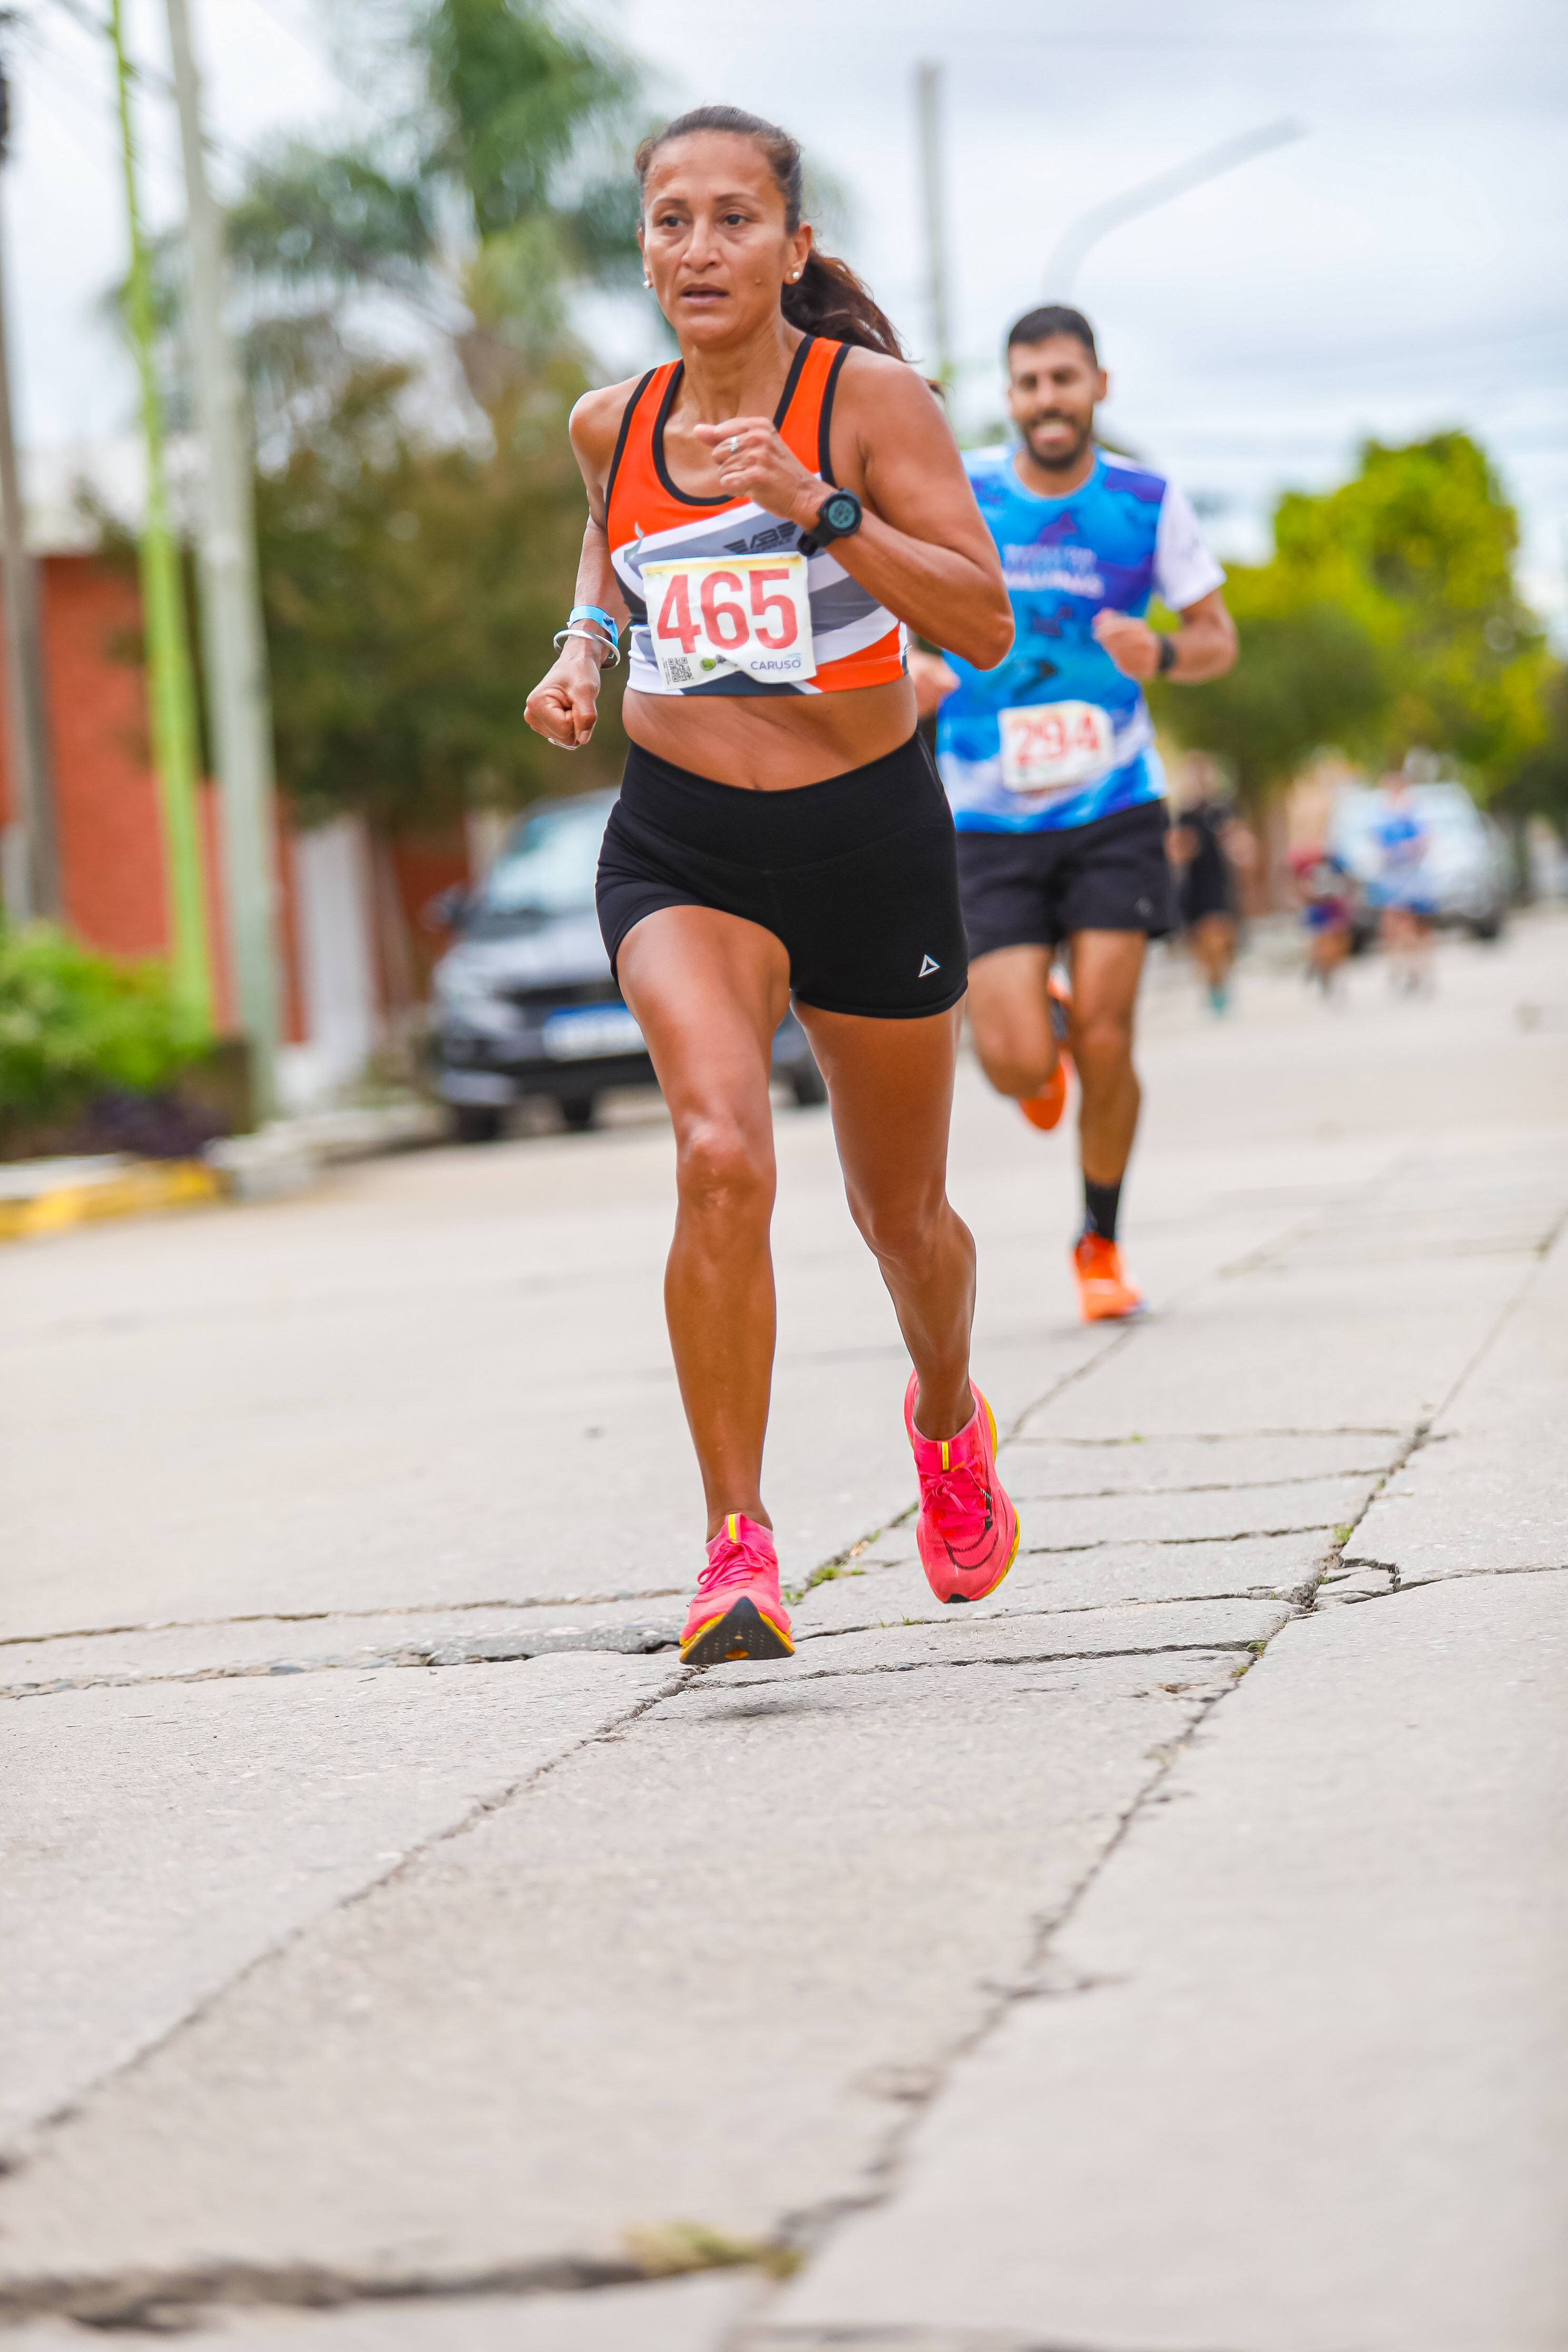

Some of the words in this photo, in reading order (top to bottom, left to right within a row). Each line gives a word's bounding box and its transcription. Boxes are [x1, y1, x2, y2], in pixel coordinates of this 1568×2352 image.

[657, 569, 798, 654] 465
[751, 659, 801, 670] CARUSO
[1010, 713, 1100, 767] 294
